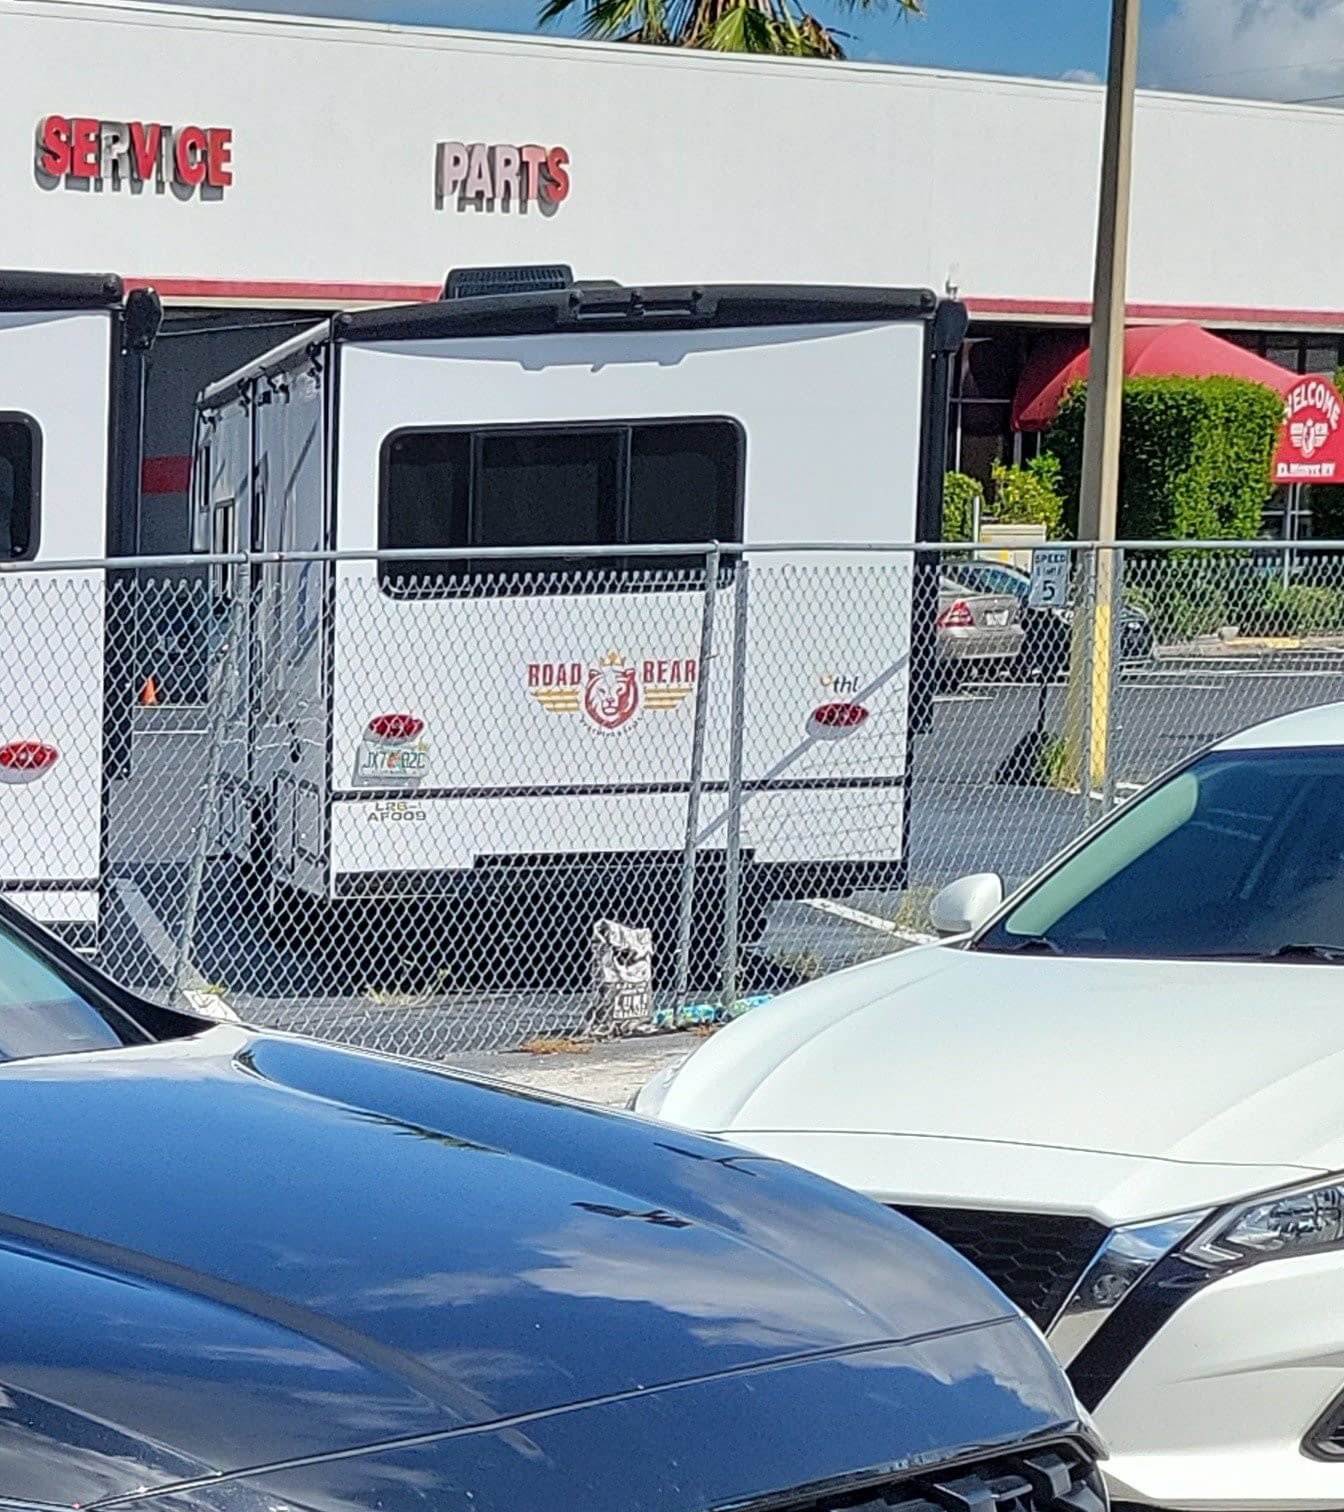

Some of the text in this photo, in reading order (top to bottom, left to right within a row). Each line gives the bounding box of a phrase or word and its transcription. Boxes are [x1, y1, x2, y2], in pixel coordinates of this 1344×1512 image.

[39, 114, 234, 188] SERVICE
[437, 141, 570, 204] PARTS
[1034, 553, 1066, 564] SPEED
[1042, 580, 1055, 601] 5
[527, 663, 583, 688] ROAD
[643, 659, 697, 684] BEAR
